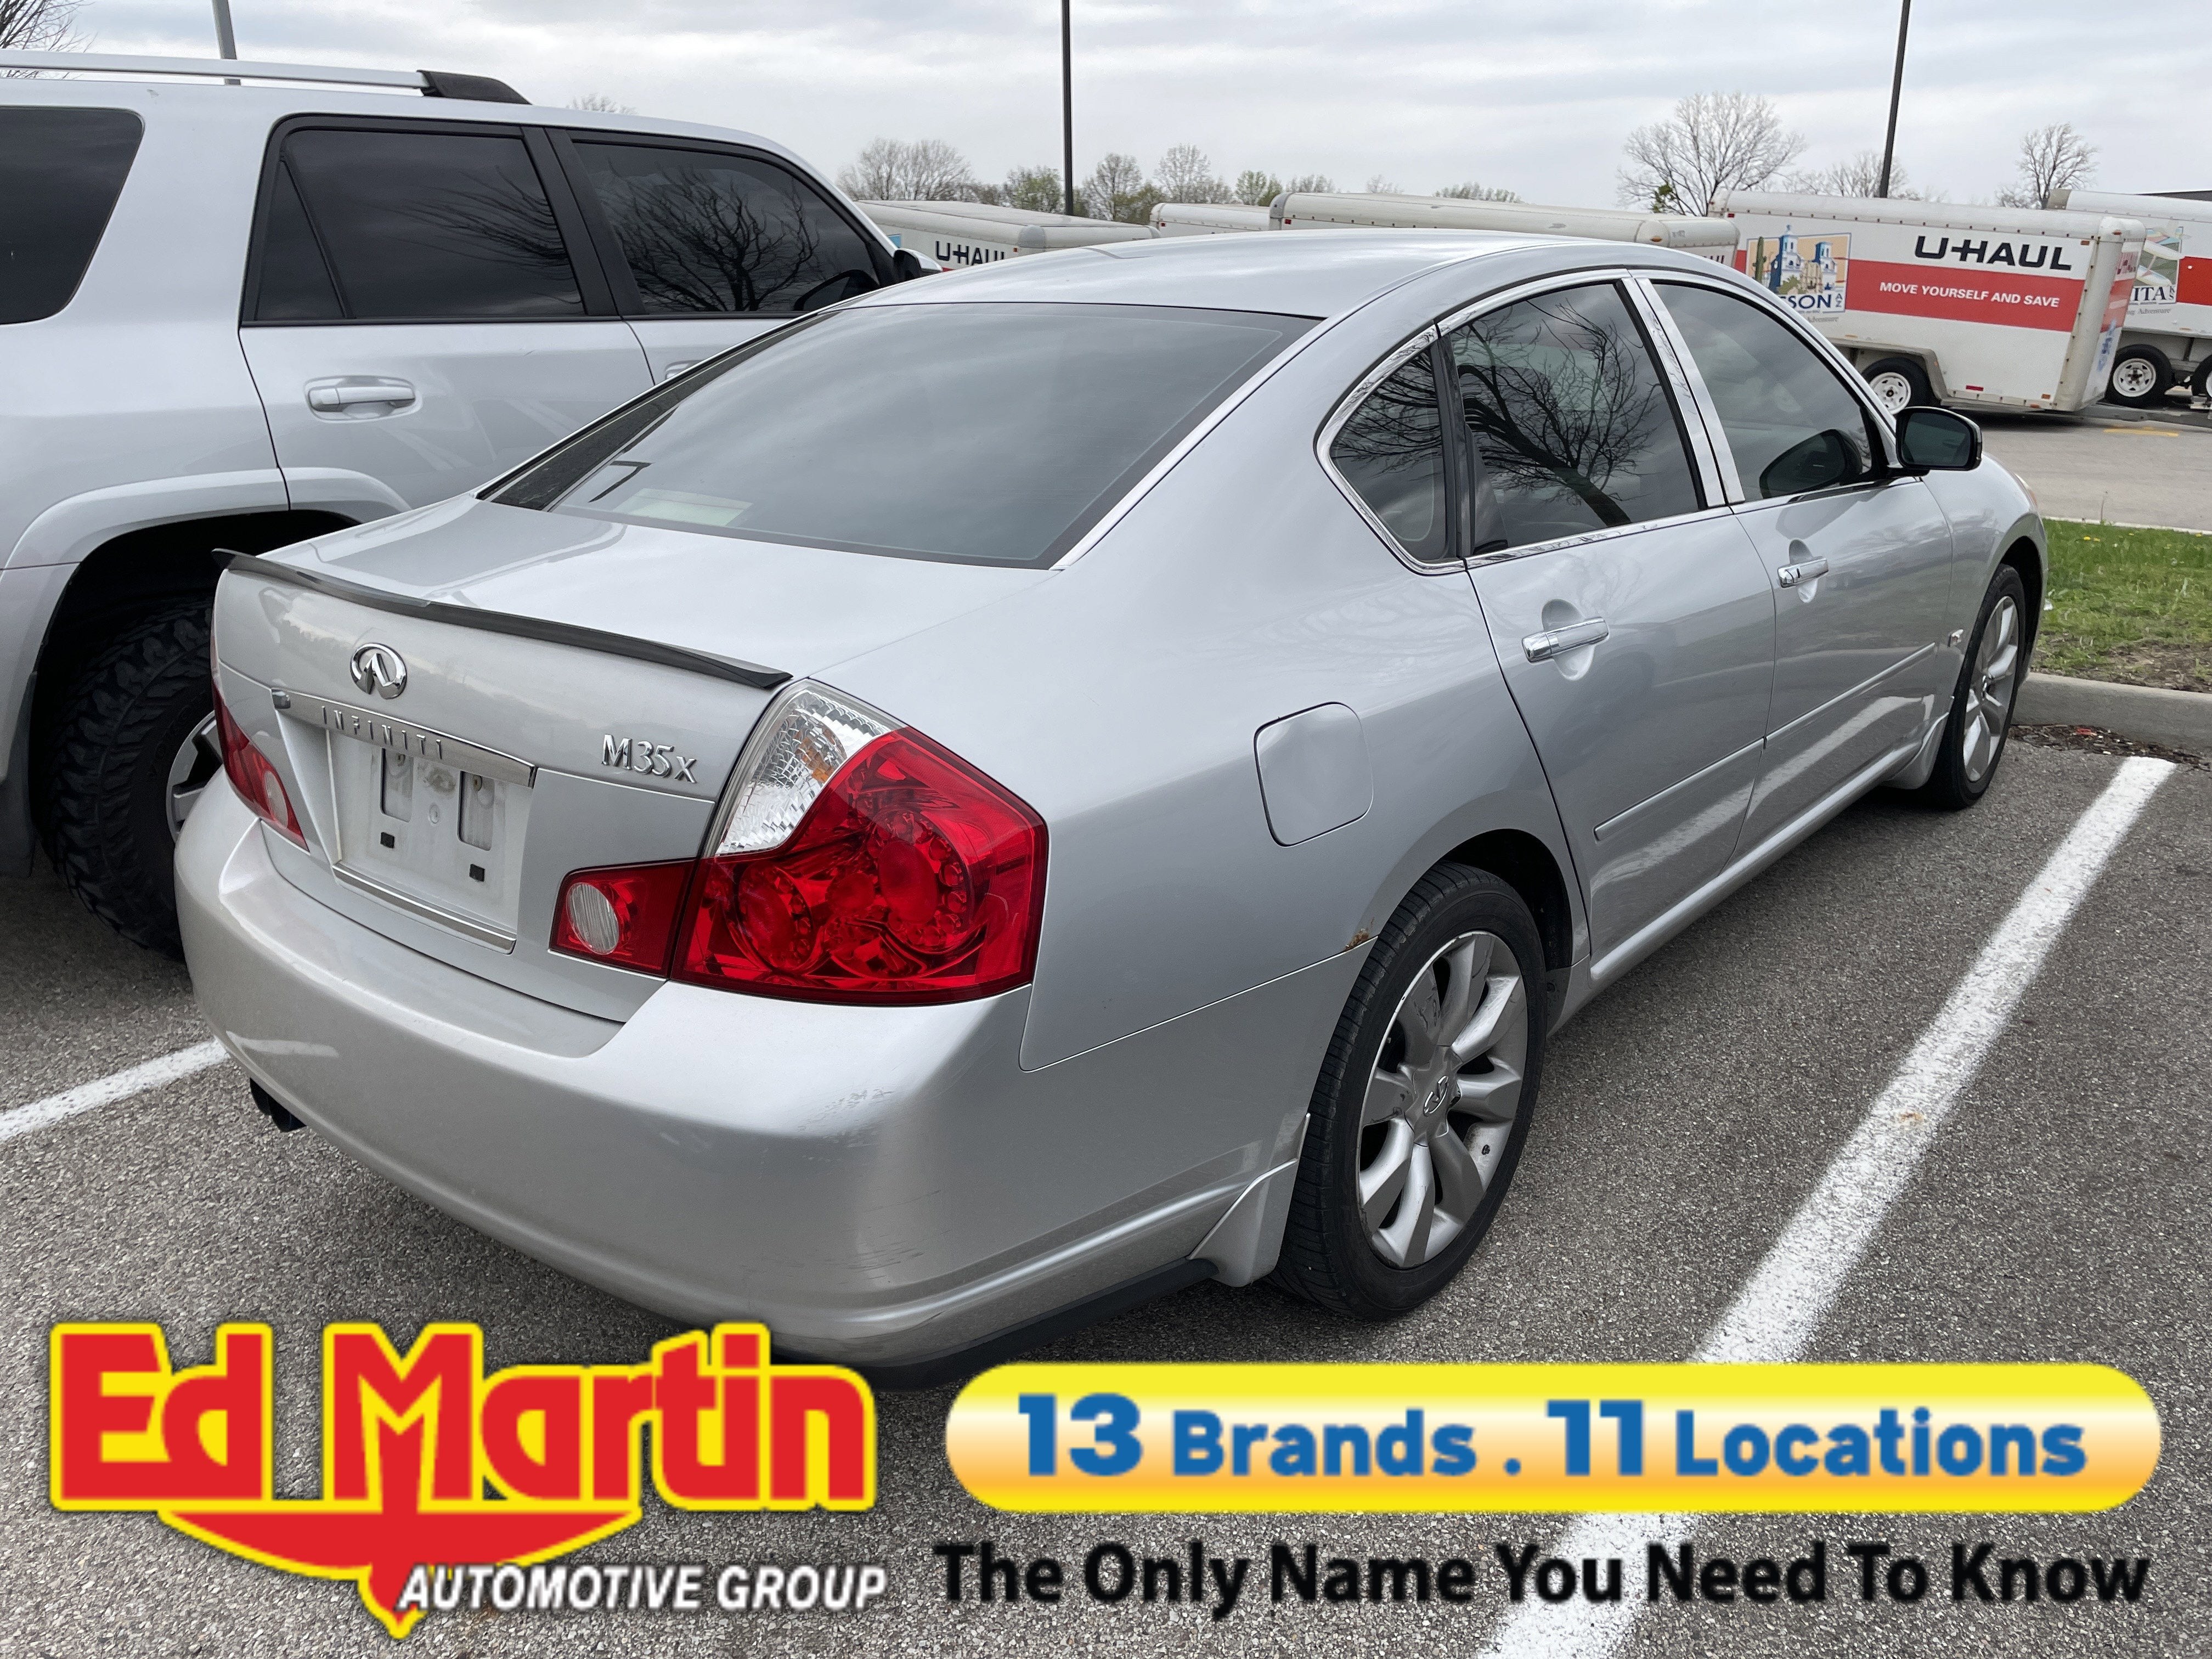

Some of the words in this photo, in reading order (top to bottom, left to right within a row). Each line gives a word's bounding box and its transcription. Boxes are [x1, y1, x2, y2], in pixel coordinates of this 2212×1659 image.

[1915, 235, 2072, 271] U-HAUL
[1781, 294, 1832, 309] SON
[1880, 281, 1918, 295] MOVE
[1921, 285, 1989, 301] YOURSELF
[1991, 292, 2021, 304] AND
[2023, 295, 2060, 308] SAVE
[2133, 286, 2167, 302] ITA
[321, 705, 443, 760] INFINITI
